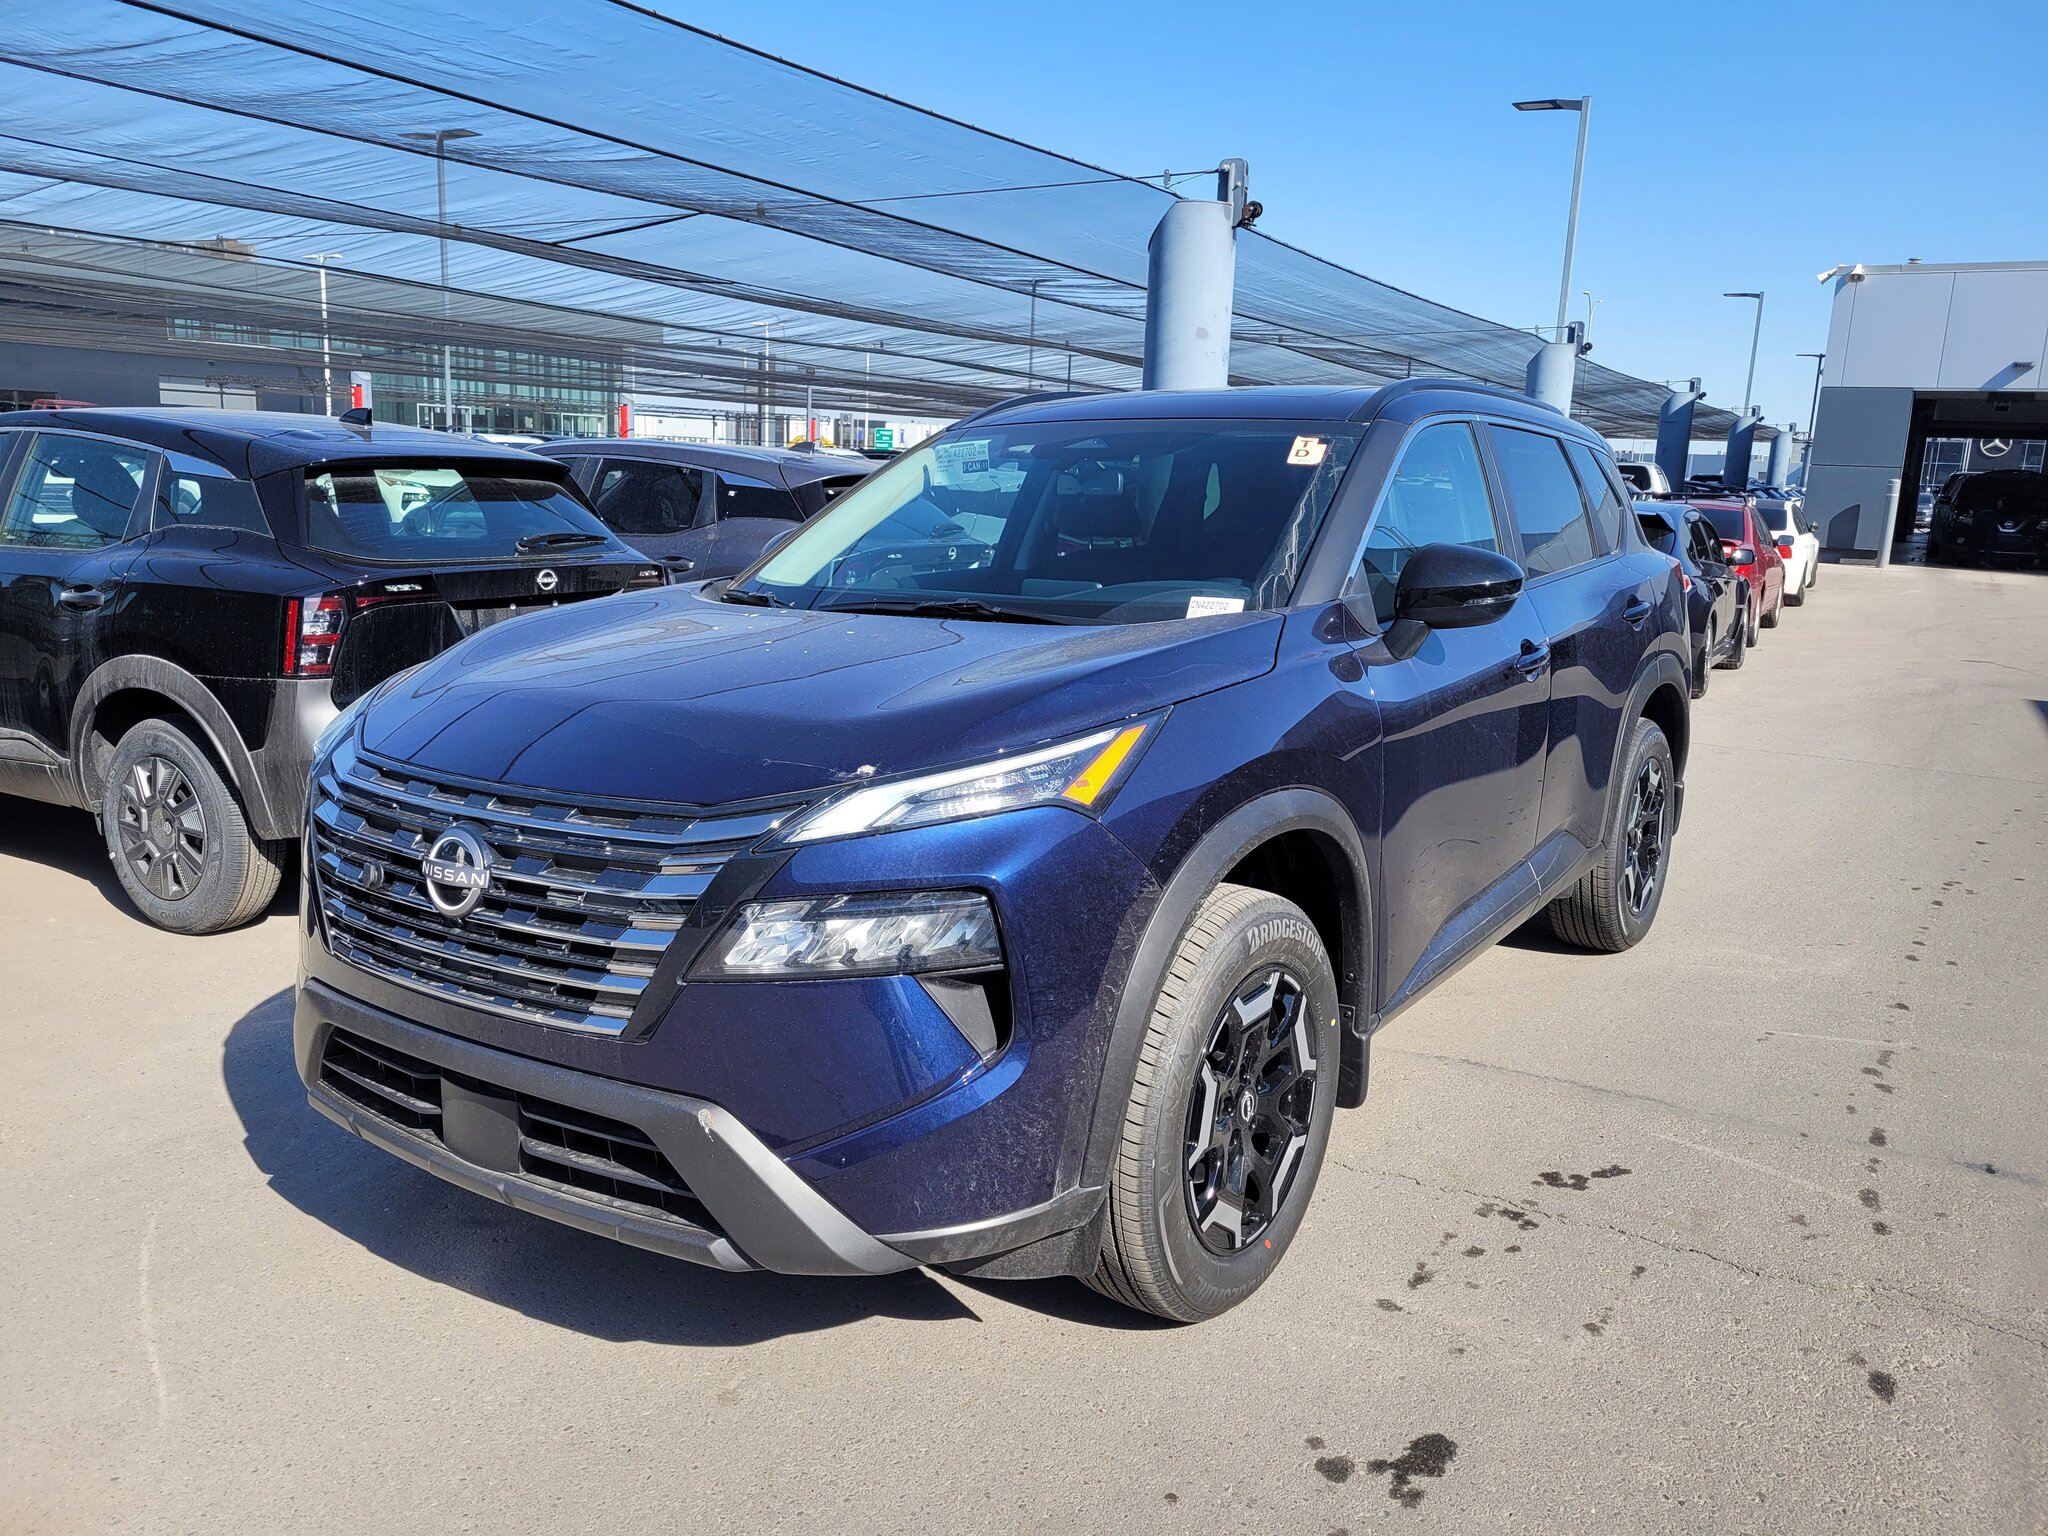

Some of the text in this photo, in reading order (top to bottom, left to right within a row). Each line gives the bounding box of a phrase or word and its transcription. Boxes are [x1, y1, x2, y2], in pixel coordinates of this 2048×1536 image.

[1300, 439, 1314, 448] T
[953, 446, 977, 458] 422702
[1295, 449, 1310, 458] D
[1191, 600, 1229, 610] CN422702
[422, 860, 486, 886] NISSAN
[1247, 918, 1325, 963] BRIDGESTONE
